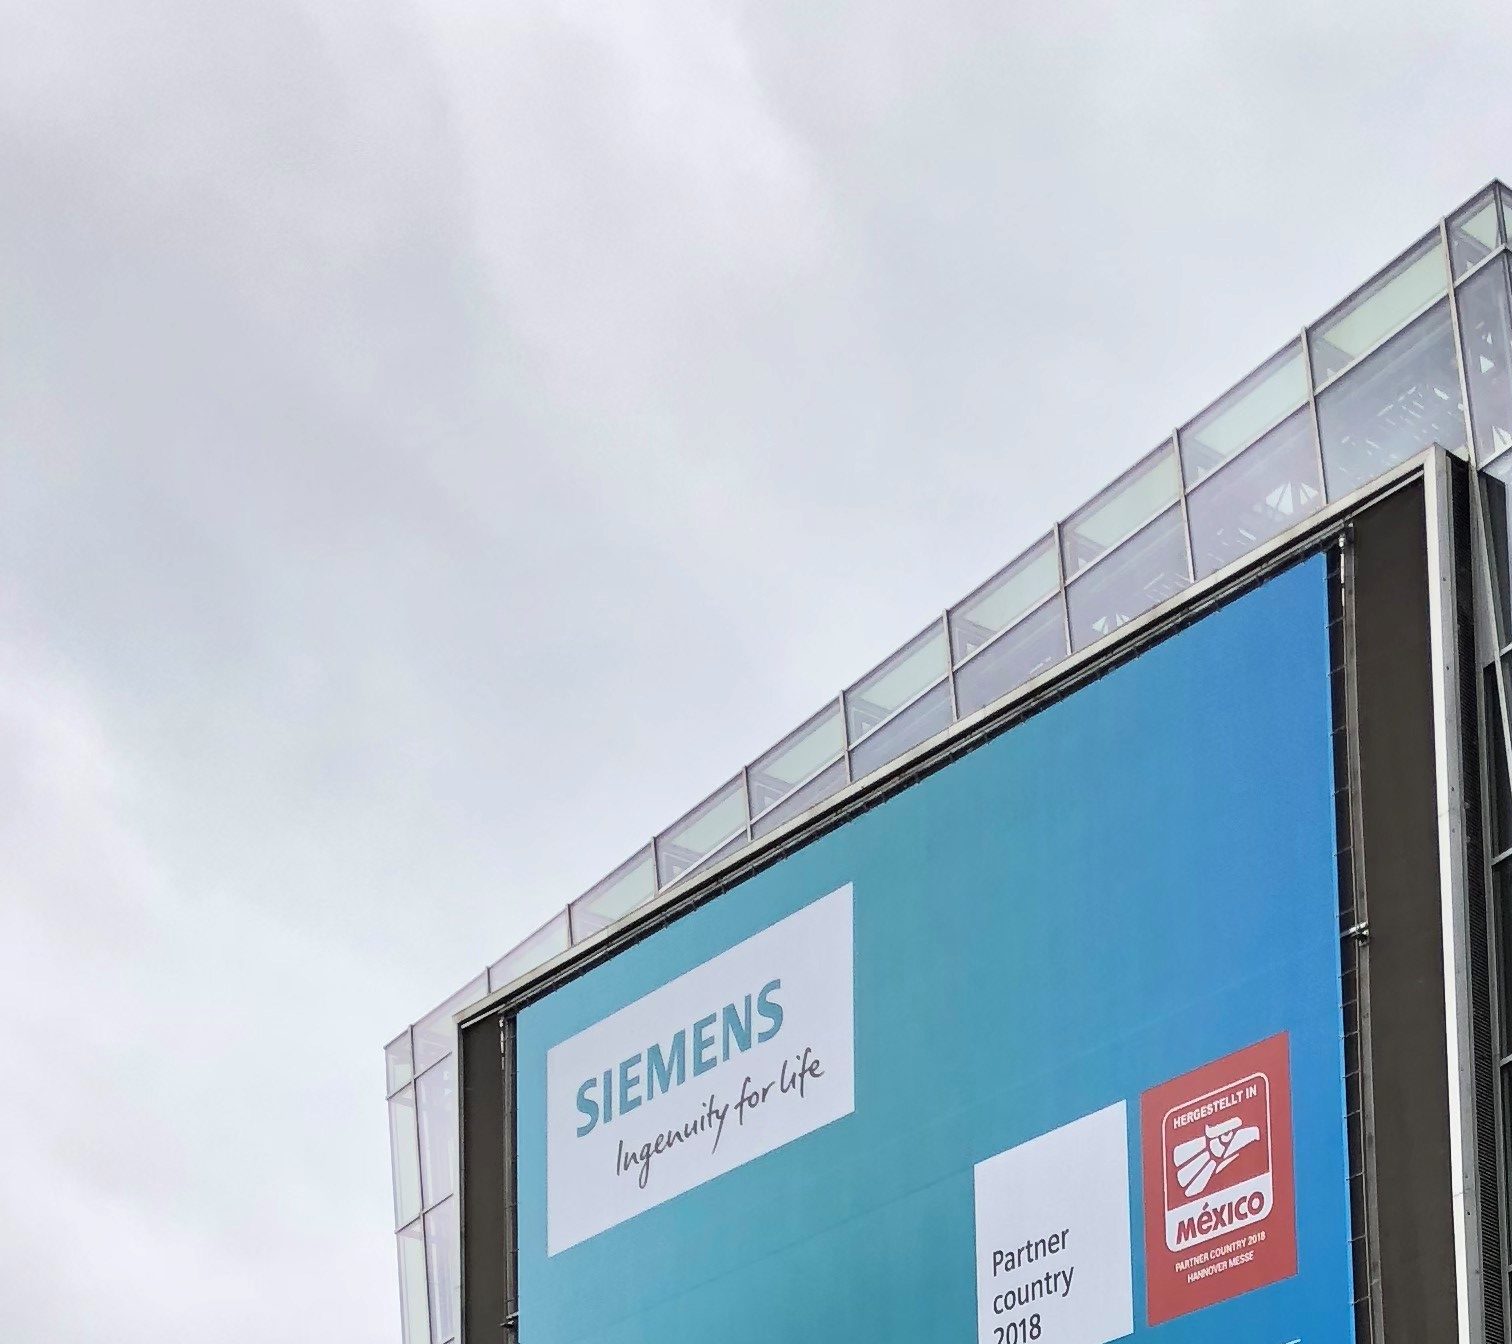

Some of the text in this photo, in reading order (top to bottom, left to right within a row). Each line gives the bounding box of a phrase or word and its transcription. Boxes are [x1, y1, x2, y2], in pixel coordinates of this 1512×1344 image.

[576, 978, 784, 1139] SIEMENS
[616, 1047, 825, 1189] Ingenuity for life
[1173, 1084, 1257, 1129] HERGESTELLT IN
[993, 1228, 1070, 1277] Partner
[1175, 1230, 1266, 1273] PARTNER COUNTRY 2018
[1187, 1250, 1255, 1284] HANNOVER MESSE
[993, 1266, 1074, 1316] country
